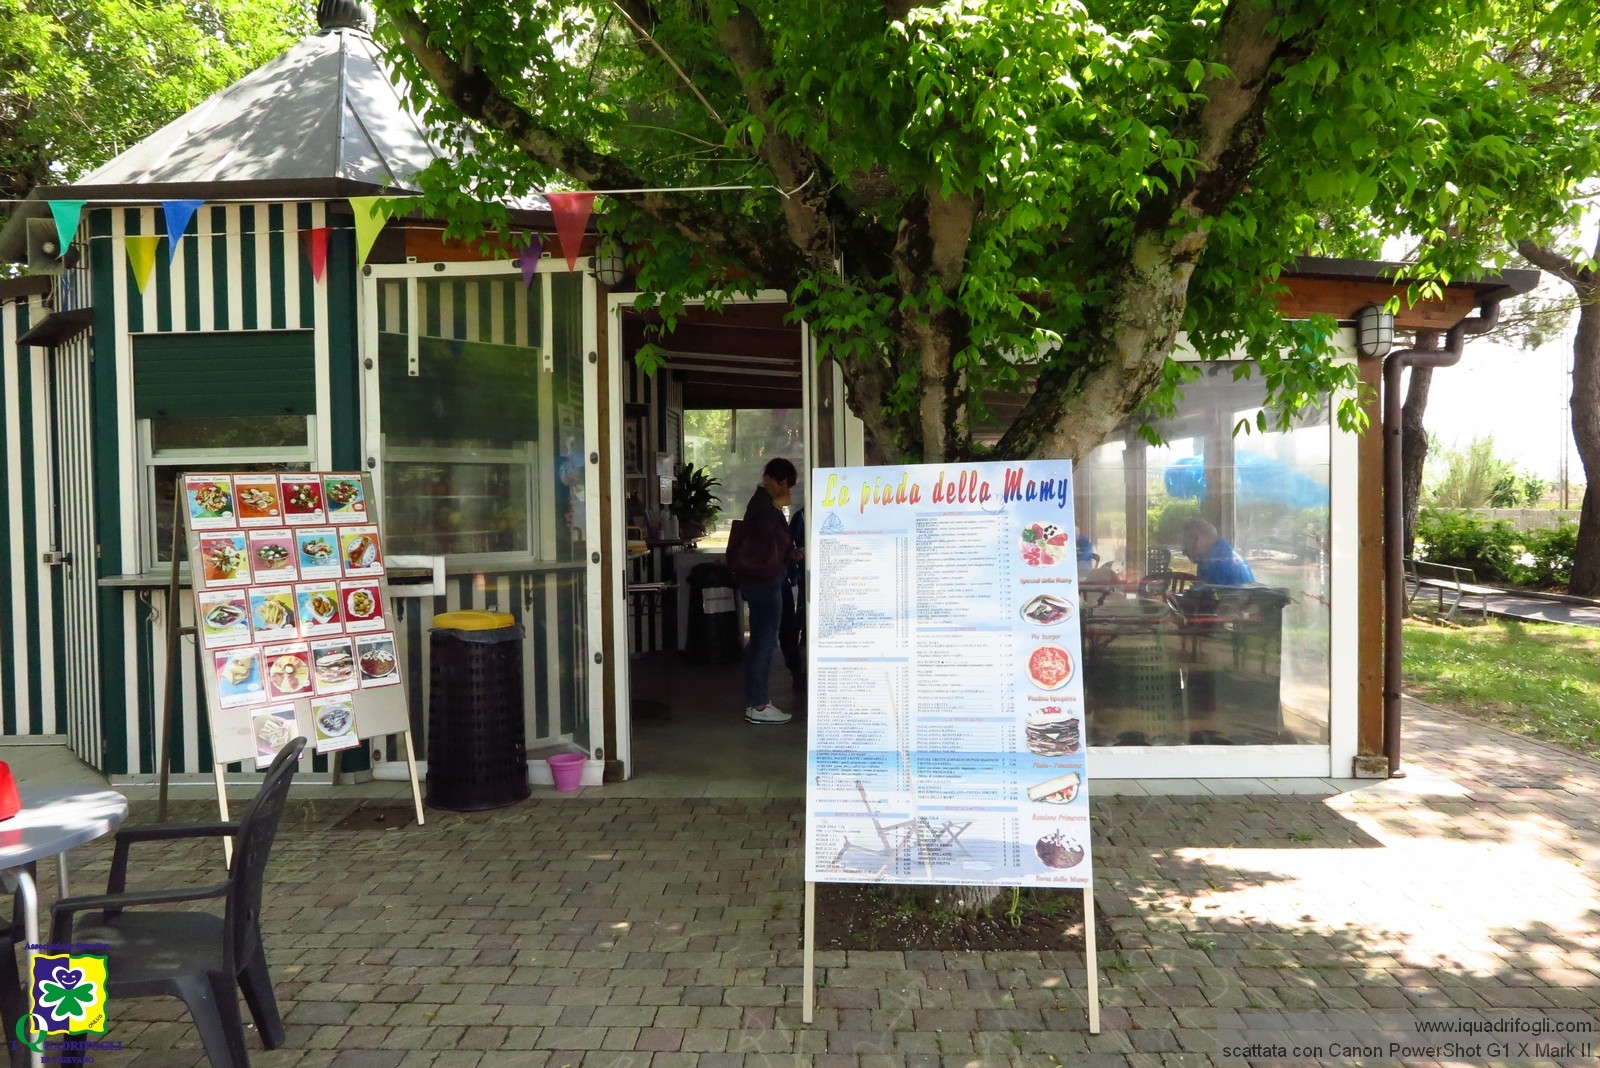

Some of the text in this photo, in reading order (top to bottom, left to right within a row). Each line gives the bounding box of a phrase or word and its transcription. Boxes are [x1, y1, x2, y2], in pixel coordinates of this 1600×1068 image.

[821, 467, 1069, 514] La piada della Mamy
